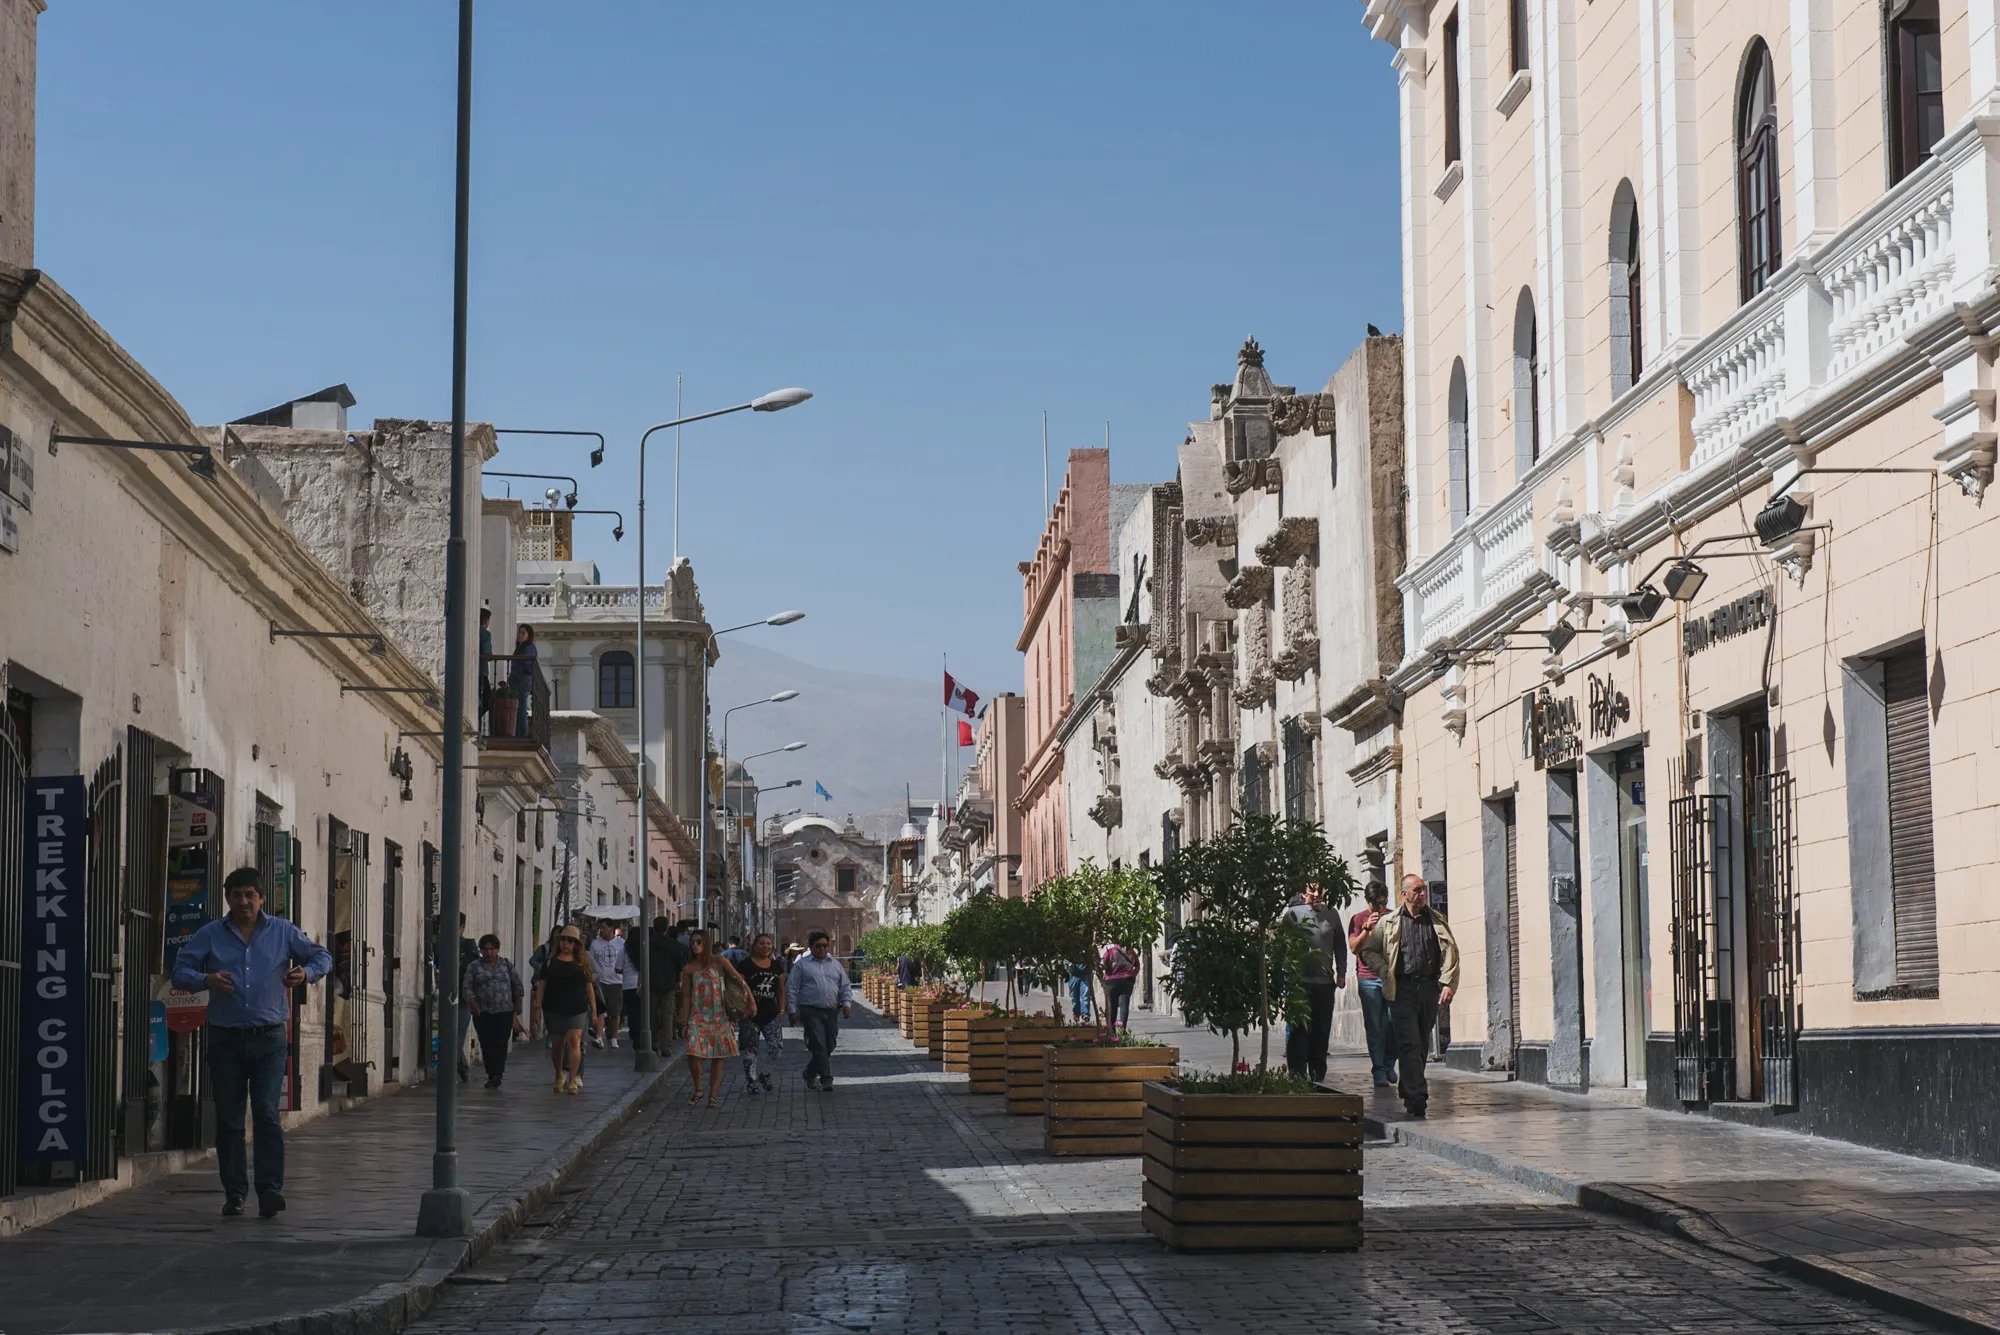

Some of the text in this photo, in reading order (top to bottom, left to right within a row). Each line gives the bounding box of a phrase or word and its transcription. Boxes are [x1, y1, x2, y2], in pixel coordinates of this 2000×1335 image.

[181, 868, 205, 876] movistar
[335, 877, 347, 889] te
[181, 911, 201, 920] entel
[167, 934, 195, 945] recar
[36, 787, 69, 1151] TREKKING COLCA
